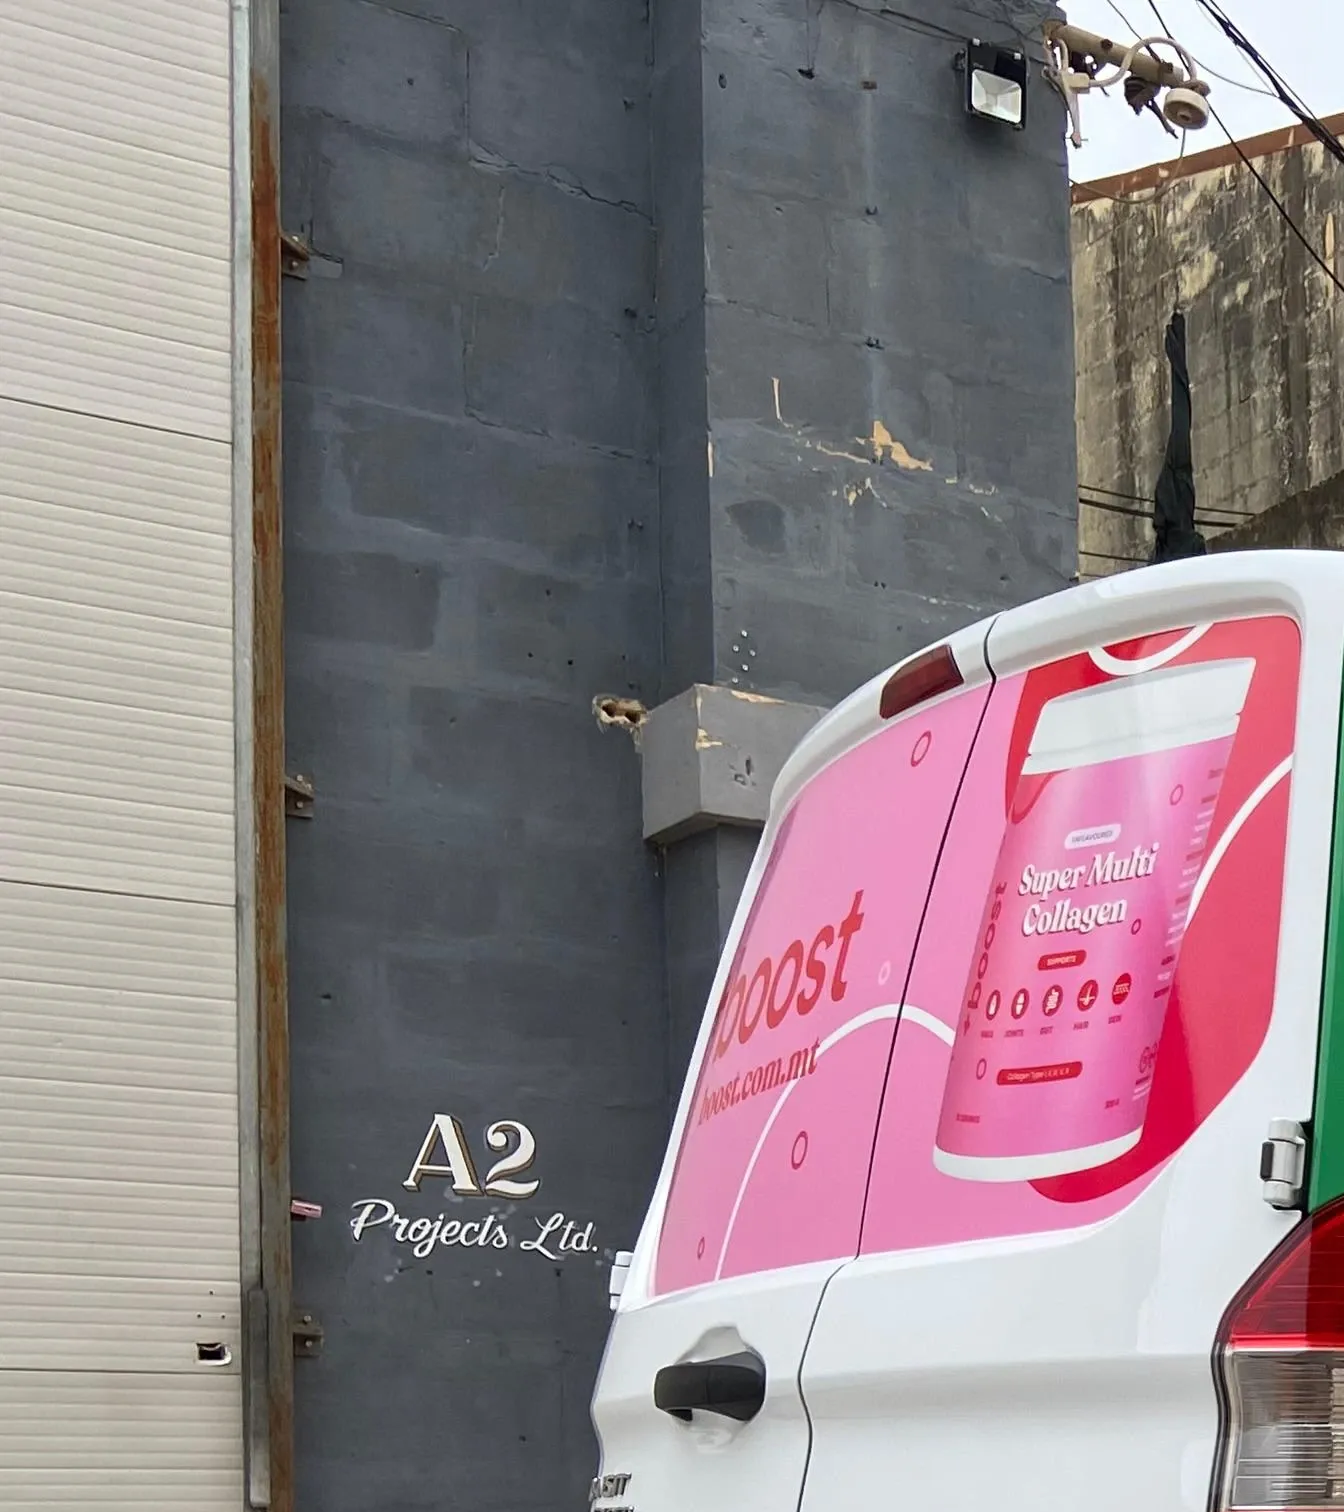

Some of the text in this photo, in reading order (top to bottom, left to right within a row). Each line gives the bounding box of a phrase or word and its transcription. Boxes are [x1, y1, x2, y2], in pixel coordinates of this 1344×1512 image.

[1018, 841, 1160, 902] Super Multi
[1022, 898, 1128, 937] Collagen
[402, 1112, 541, 1198] A2
[350, 1199, 599, 1260] Projects Ltd.
